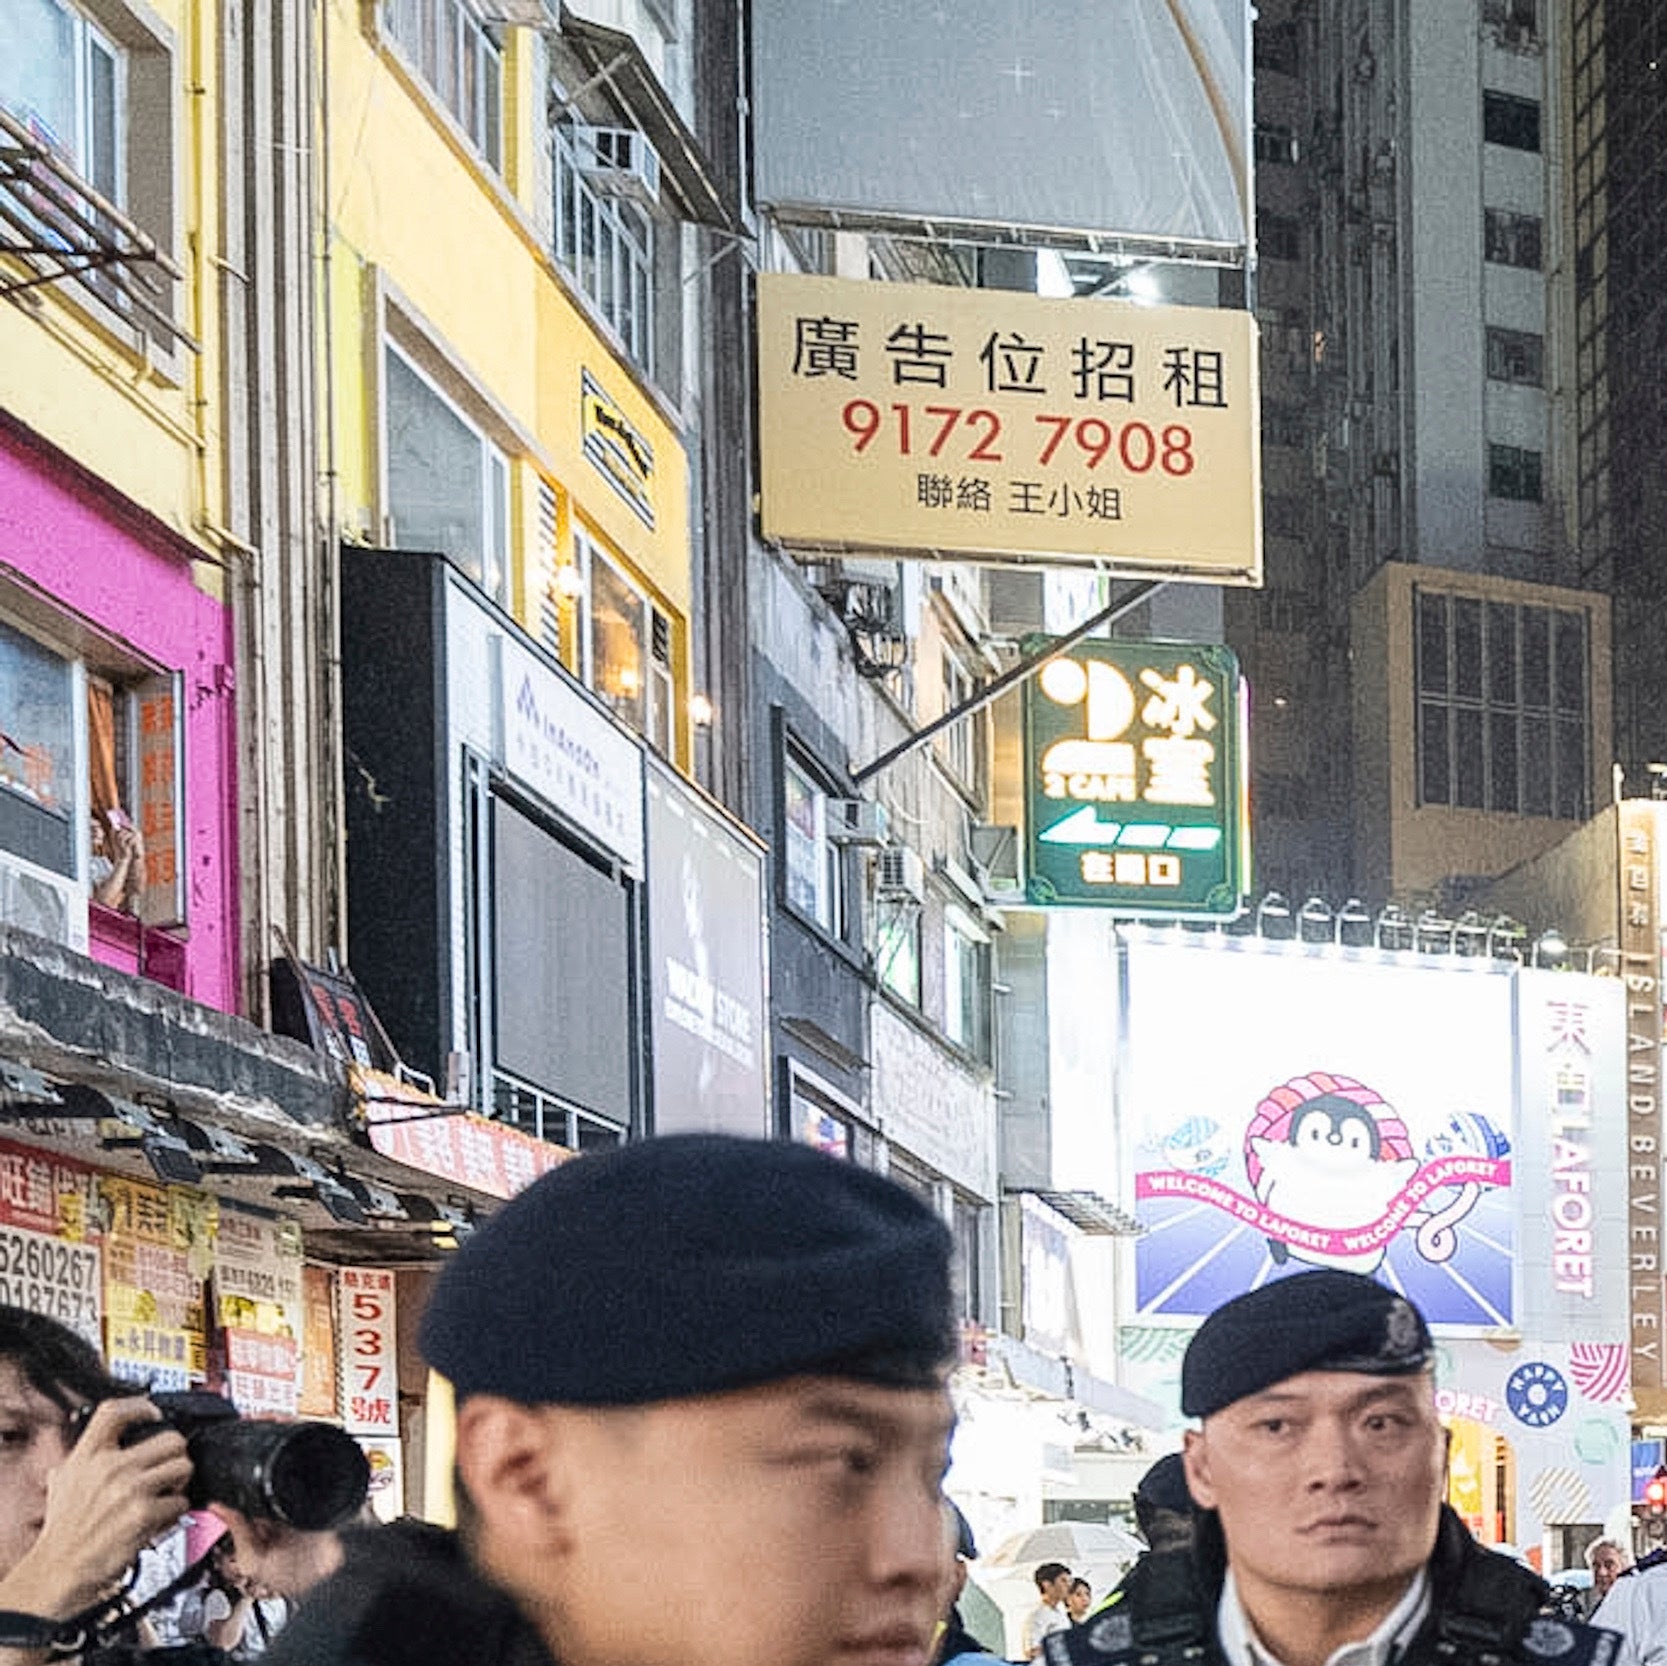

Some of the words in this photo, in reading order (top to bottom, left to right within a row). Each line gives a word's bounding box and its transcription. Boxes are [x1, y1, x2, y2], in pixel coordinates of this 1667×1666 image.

[792, 316, 1228, 410] 廣告位招租
[842, 399, 1002, 463] 9172
[1034, 413, 1195, 477] 7908
[917, 473, 992, 514] 聯絡
[1009, 480, 1123, 521] 王小姐
[1628, 953, 1656, 1116] ISLAND
[1148, 1175, 1237, 1210] WELCOME
[1233, 1199, 1258, 1220] TO
[1259, 1212, 1331, 1249] LAFORET
[1343, 1199, 1409, 1252] WELCOME
[1409, 1180, 1428, 1202] TO
[1427, 1162, 1498, 1190] LAFORET
[1553, 1116, 1593, 1298] LAFORET
[1632, 1136, 1660, 1362] BEVERLEY
